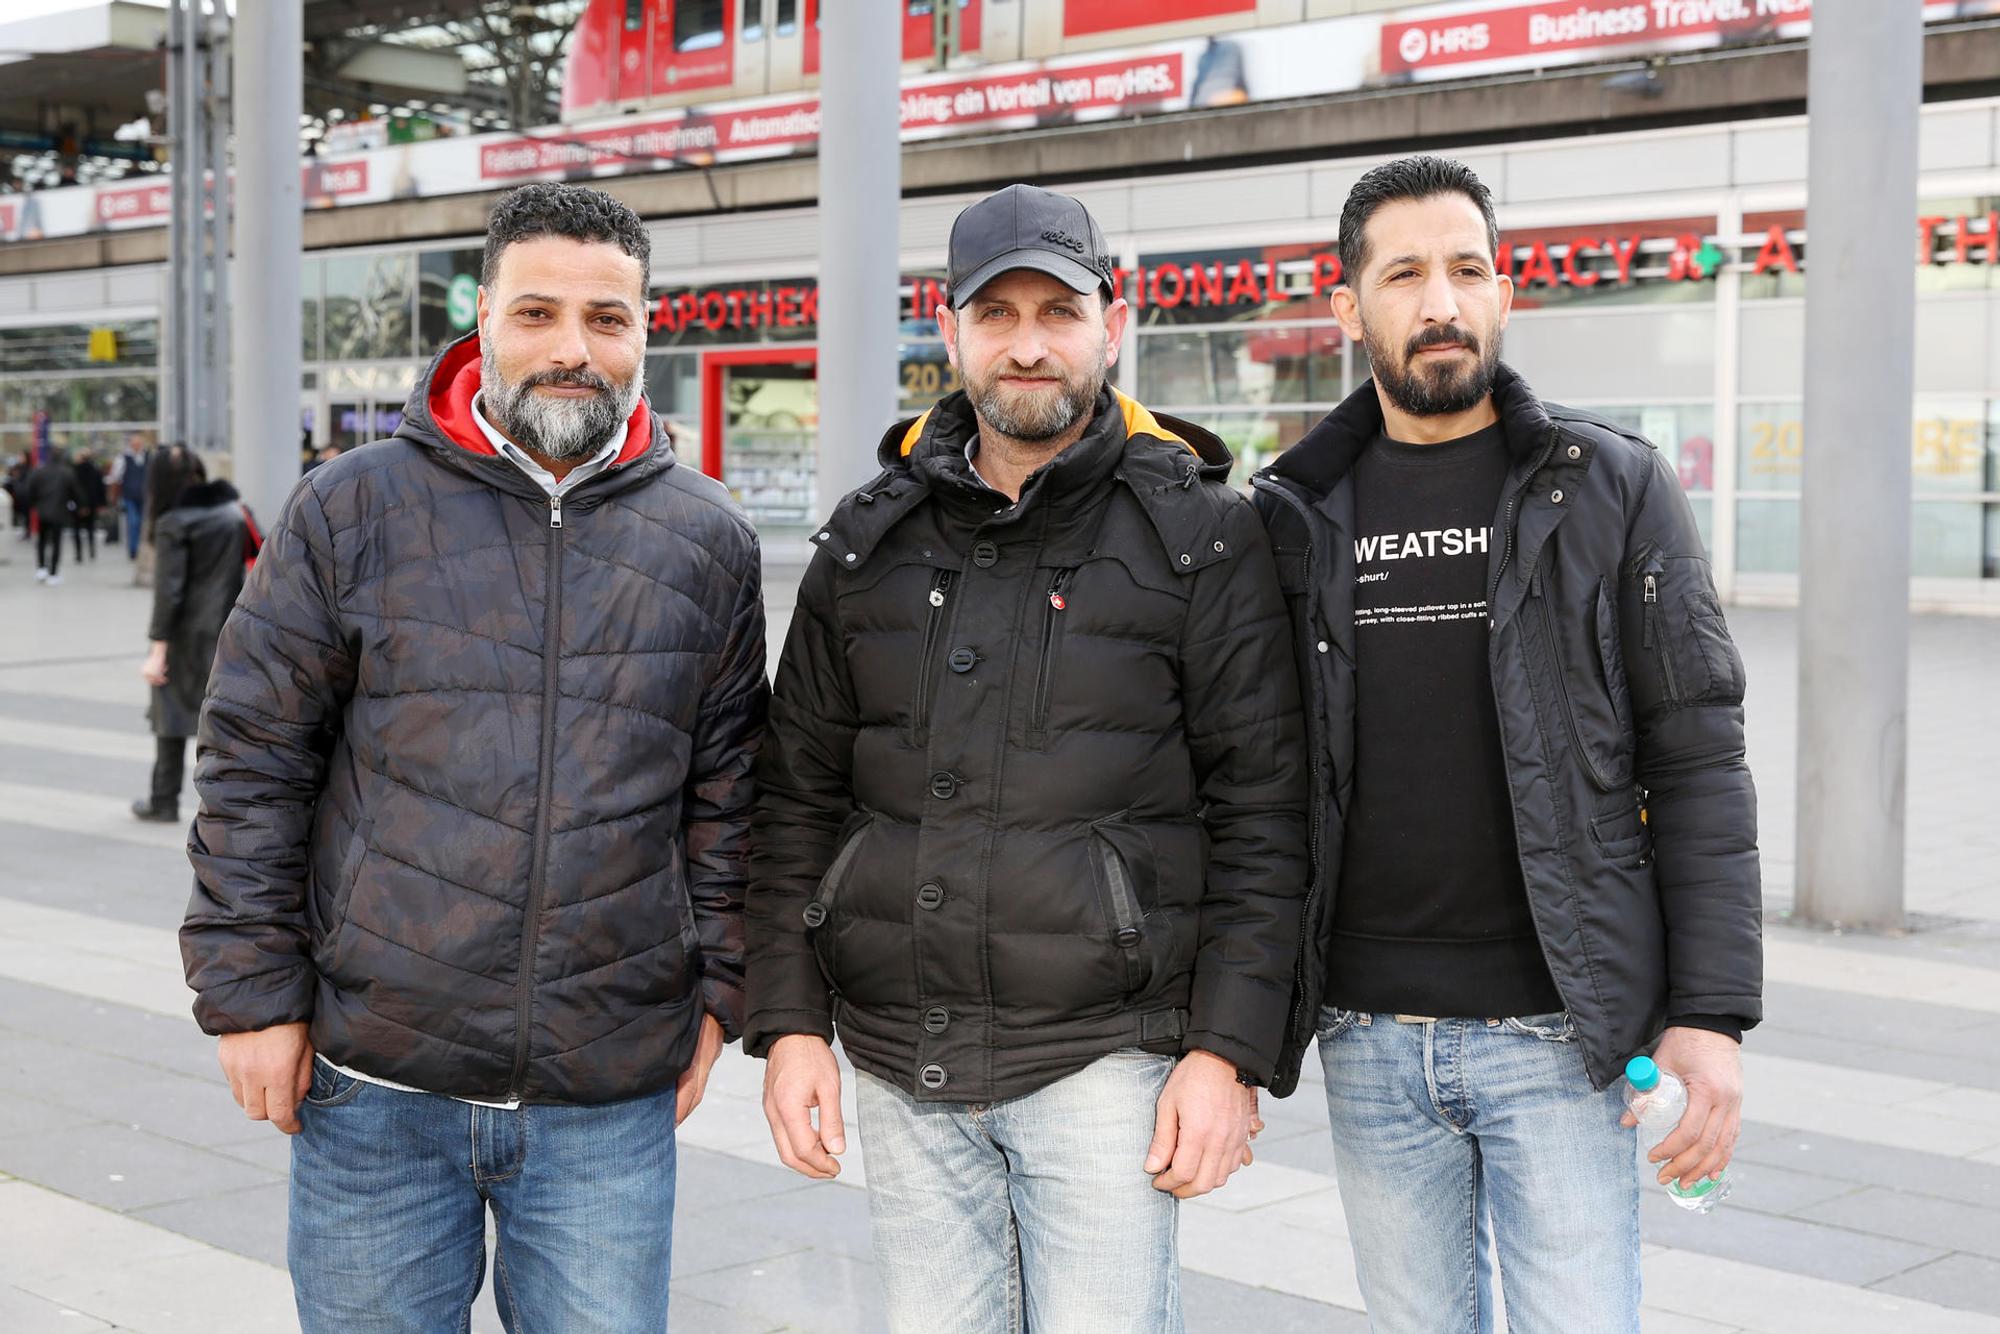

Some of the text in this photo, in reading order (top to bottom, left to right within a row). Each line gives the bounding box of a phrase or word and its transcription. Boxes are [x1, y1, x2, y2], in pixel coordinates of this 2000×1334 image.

[1431, 24, 1489, 54] HRS
[1529, 5, 1647, 44] Business
[954, 88, 984, 115] ein
[986, 78, 1051, 112] Vorteil
[1053, 78, 1092, 103] von
[1312, 253, 1342, 297] P
[904, 362, 940, 394] 20
[1374, 604, 1417, 614] long-sleeved
[1419, 603, 1445, 613] pullover
[1447, 603, 1458, 611] top
[1438, 612, 1459, 620] ribbed
[1461, 611, 1477, 619] cuffs
